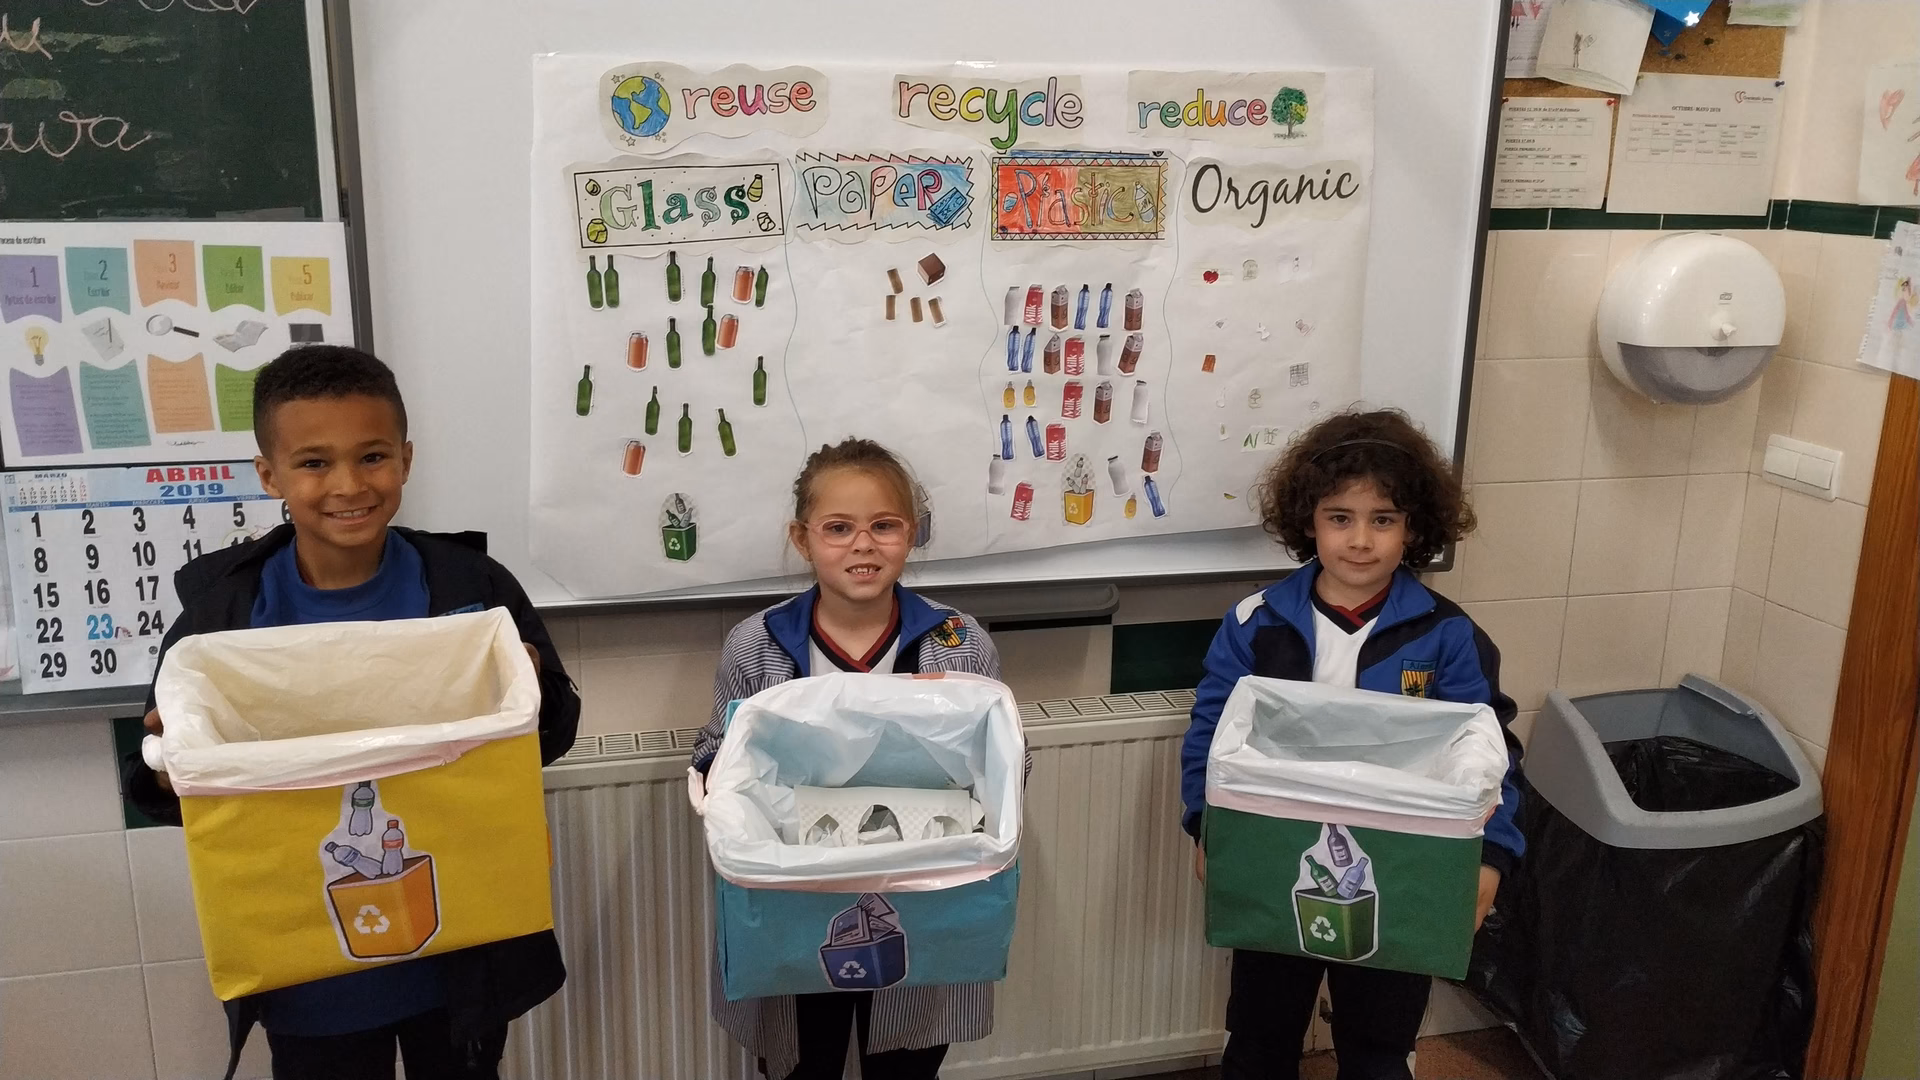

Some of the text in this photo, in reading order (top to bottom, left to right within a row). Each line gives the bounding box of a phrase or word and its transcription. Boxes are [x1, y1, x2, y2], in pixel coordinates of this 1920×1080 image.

[682, 76, 1268, 149] reuse recycle reduce
[599, 179, 750, 231] Glass
[1191, 163, 1360, 229] Organic
[98, 260, 108, 280] 2
[168, 253, 177, 273] 3
[235, 256, 243, 277] 4
[30, 266, 39, 288] 1
[302, 264, 312, 285] 5
[1025, 304, 1037, 324] Milk
[1066, 354, 1077, 374] Milk
[1064, 398, 1075, 418] Milk
[1049, 440, 1060, 460] Milk
[146, 465, 236, 483] ABRIL
[159, 483, 224, 498] 2019
[1013, 495, 1025, 519] Milk
[31, 500, 293, 537] 1 2 3 4 5 6
[34, 539, 202, 573] 8 9 10 11
[34, 576, 159, 609] 15 16 17
[36, 610, 164, 644] 22 23 24
[40, 648, 117, 678] 29 30
